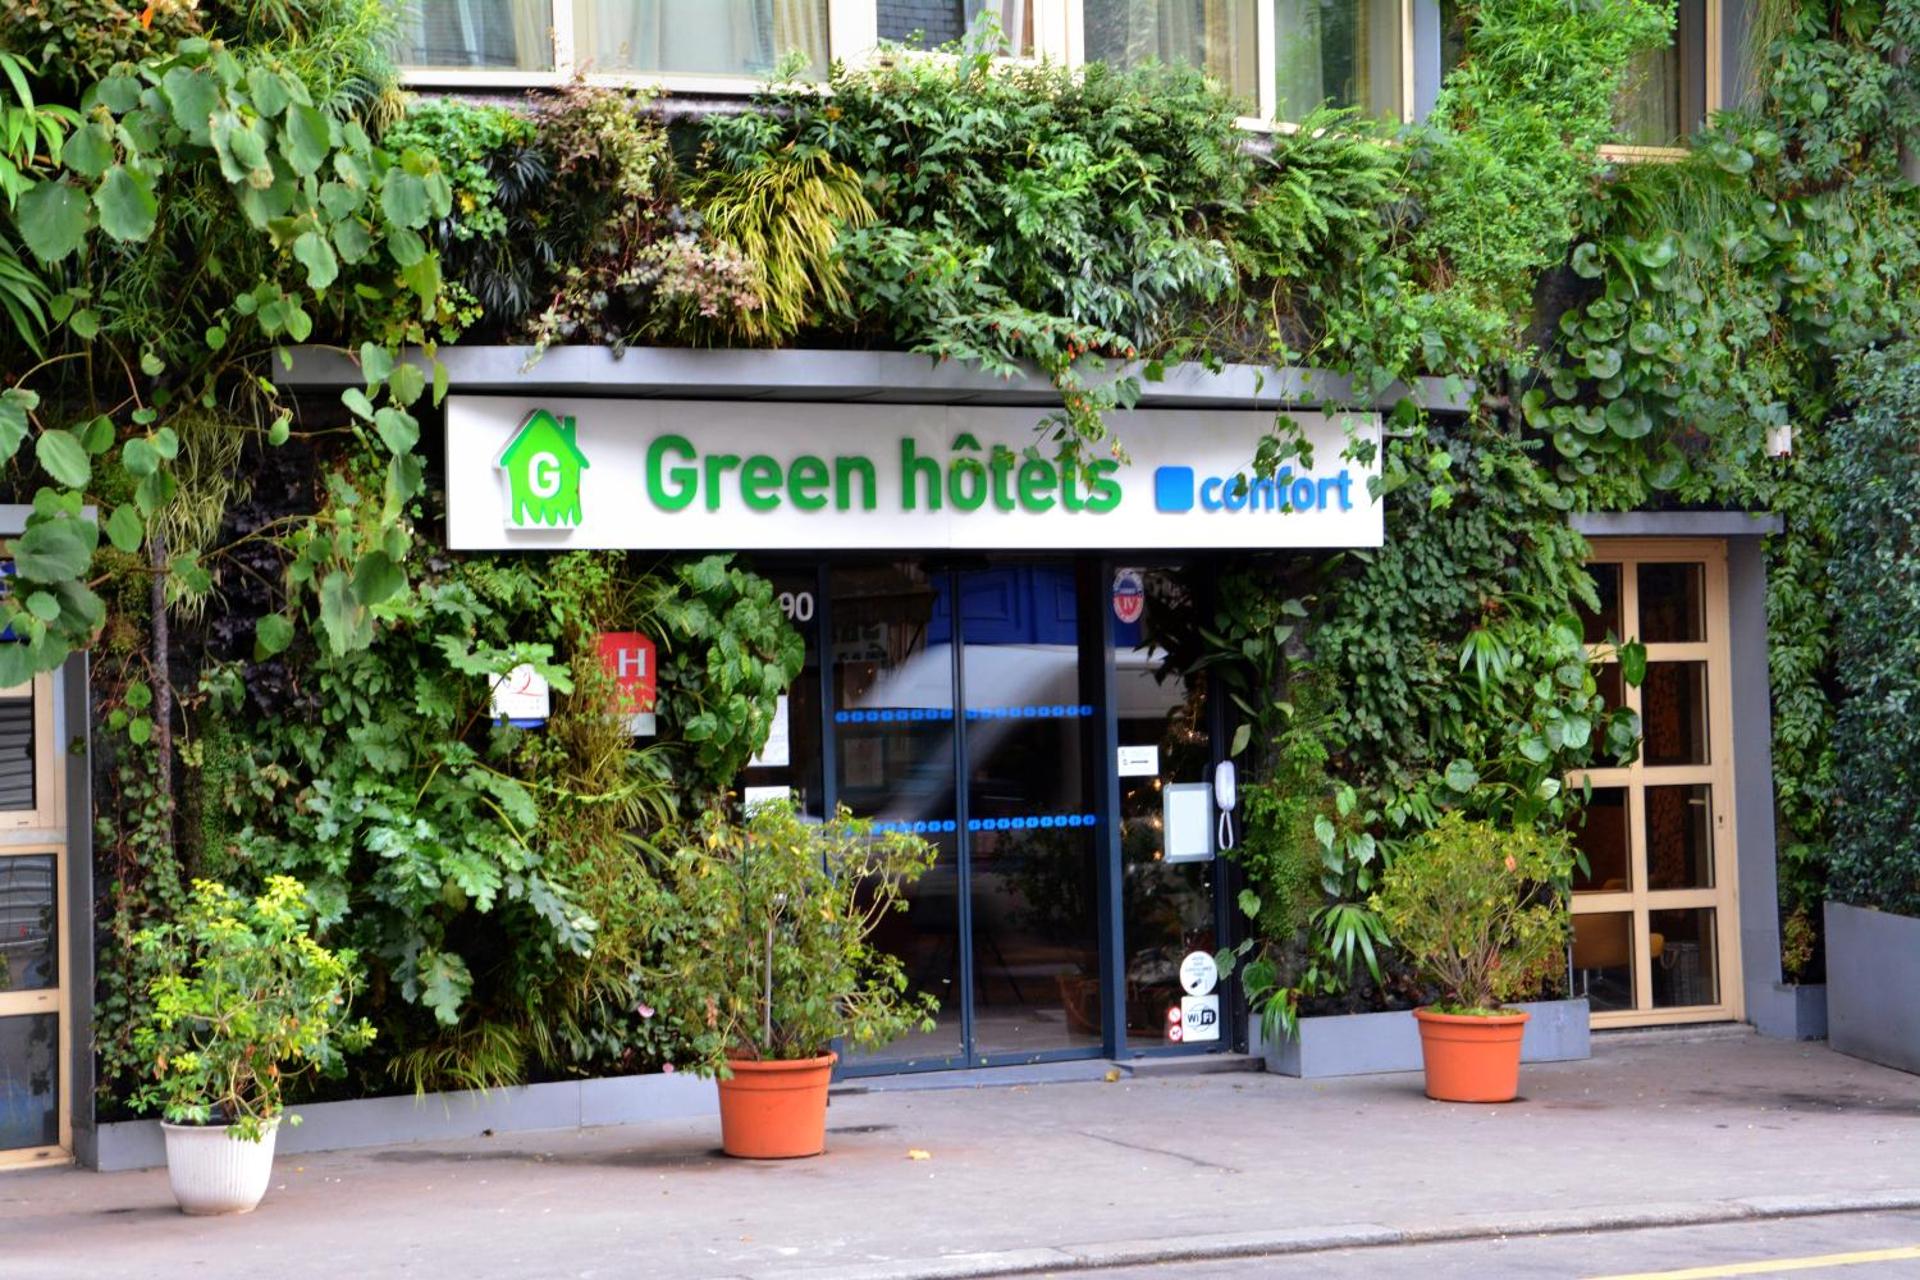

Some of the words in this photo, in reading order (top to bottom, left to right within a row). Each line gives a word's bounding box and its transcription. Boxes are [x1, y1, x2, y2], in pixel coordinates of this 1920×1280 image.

[528, 451, 561, 499] G
[646, 434, 877, 511] Green
[901, 432, 1122, 512] hôtels
[1201, 465, 1353, 512] confort
[779, 591, 814, 621] 90
[618, 648, 646, 677] H
